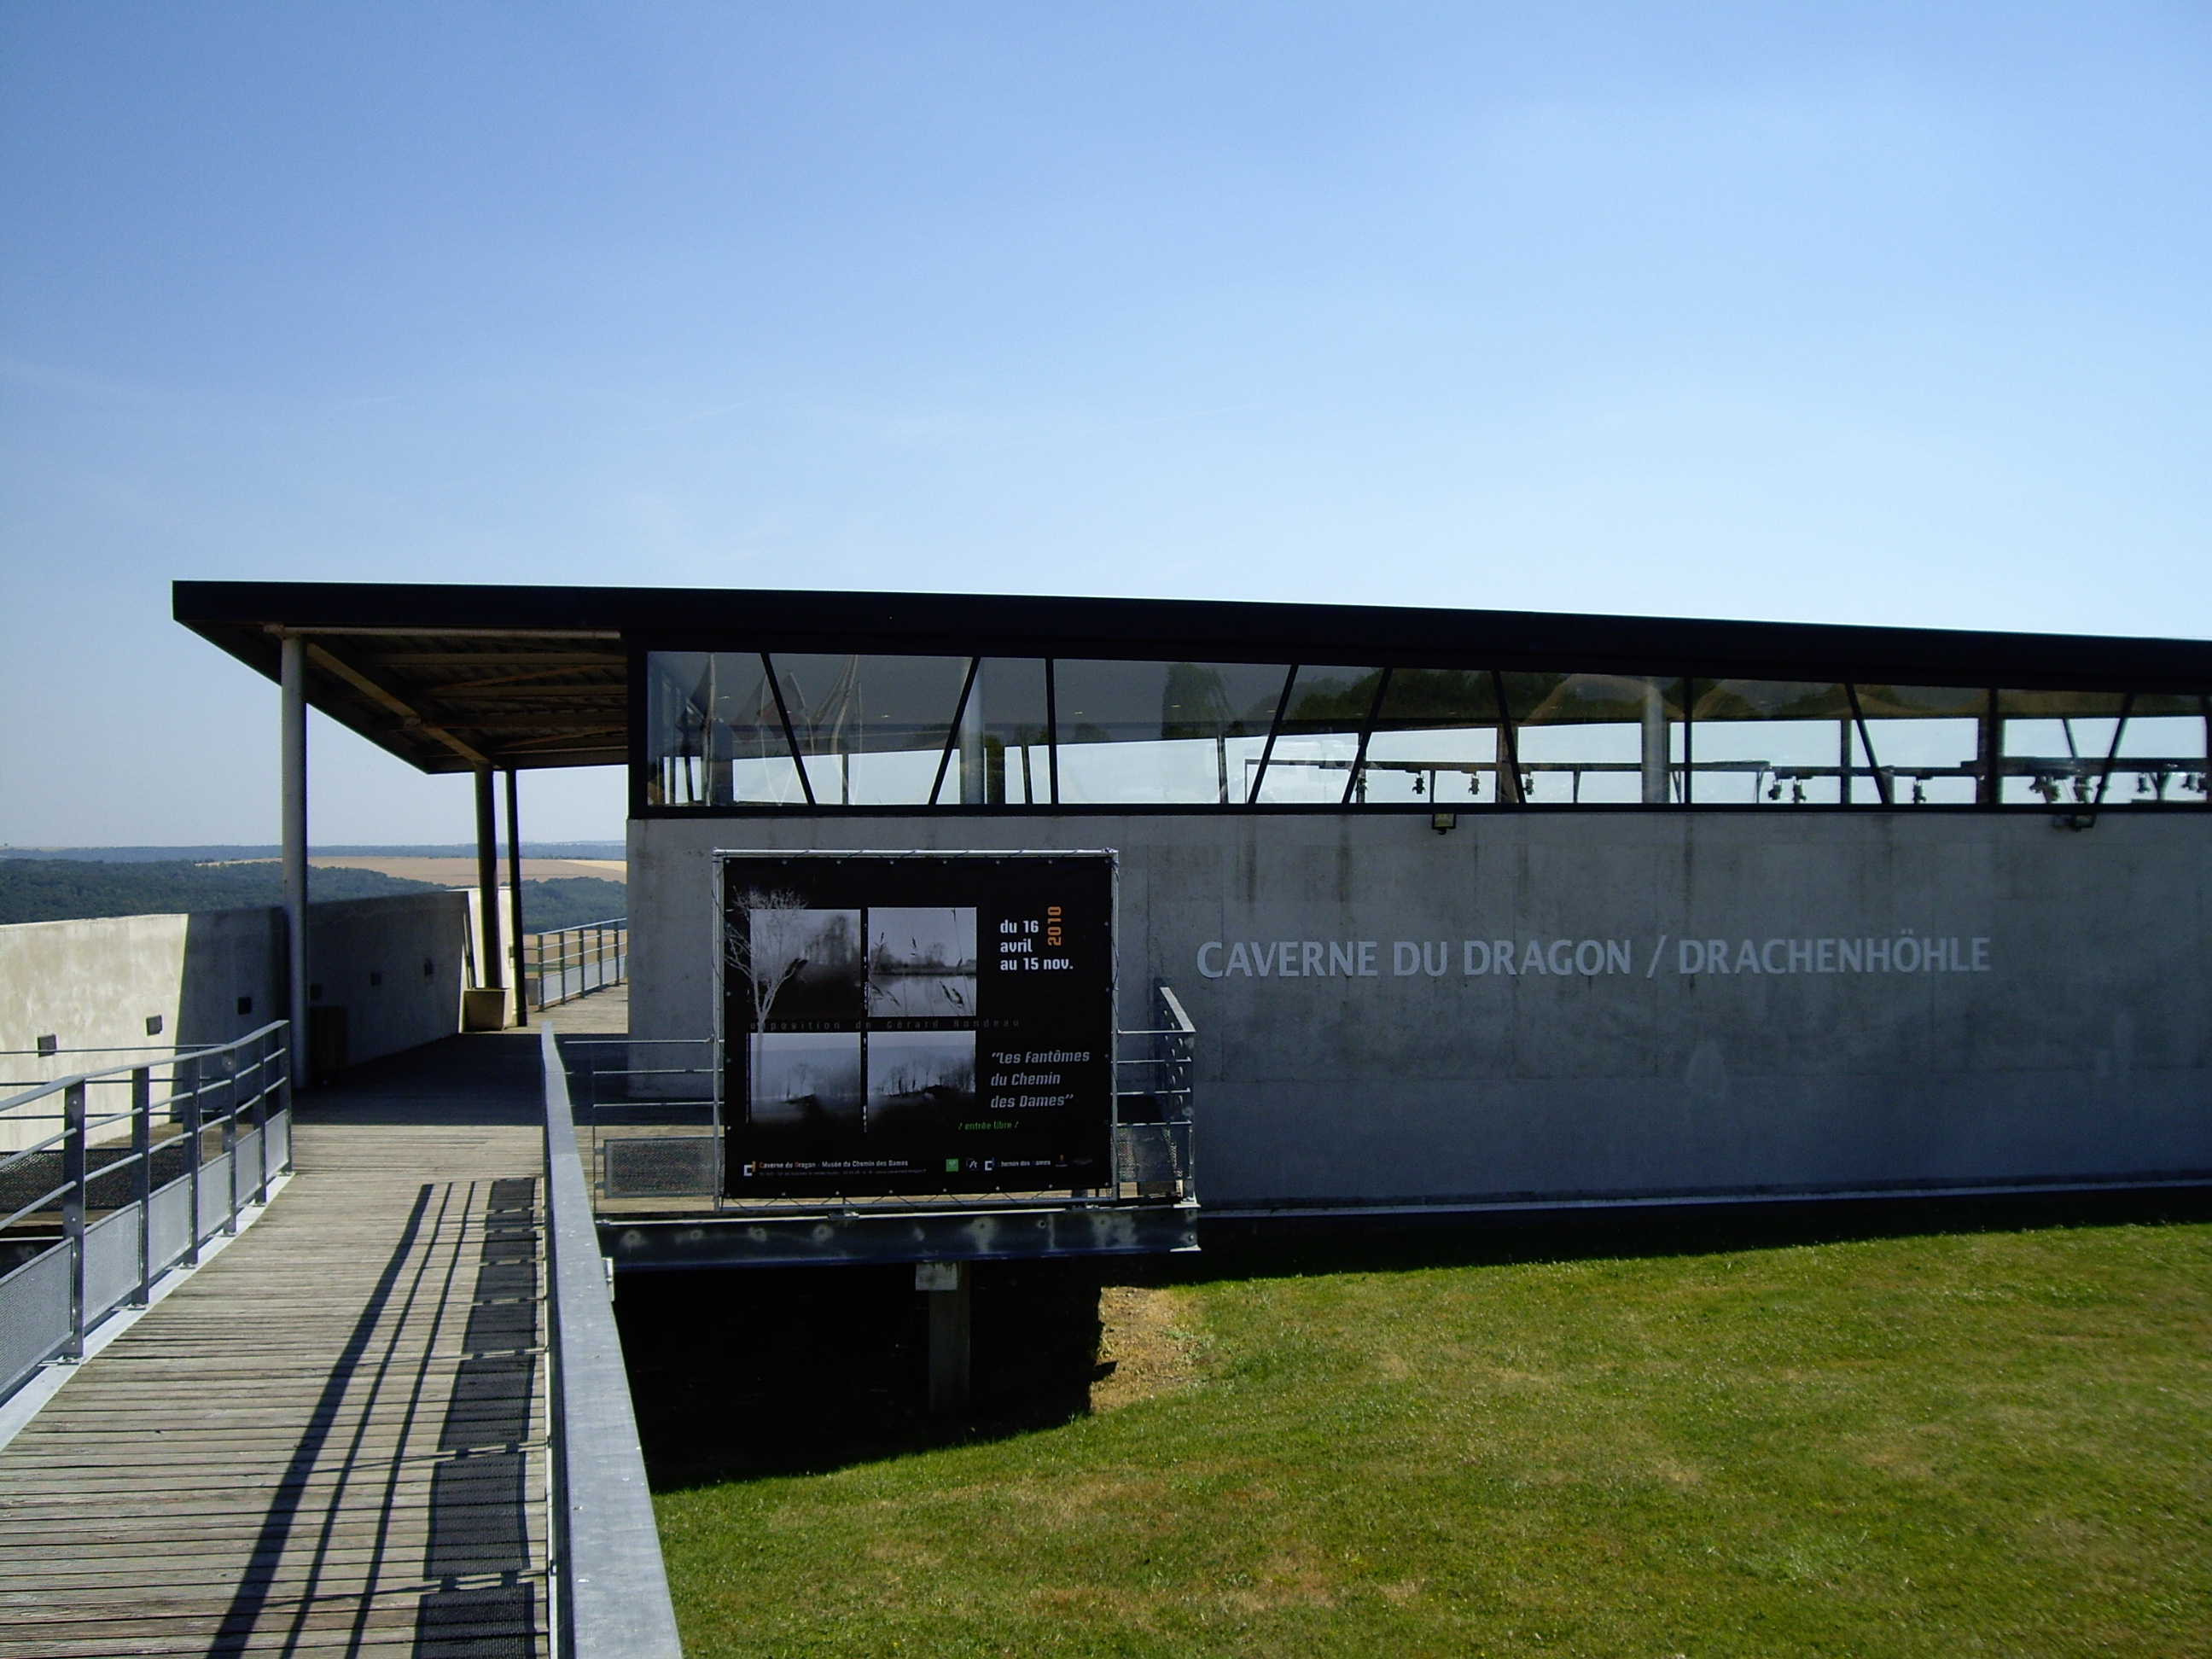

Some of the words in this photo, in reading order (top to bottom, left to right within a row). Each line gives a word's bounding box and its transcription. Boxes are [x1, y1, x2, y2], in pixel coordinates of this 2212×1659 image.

[999, 919, 1017, 934] du
[1022, 920, 1039, 934] 16
[1047, 905, 1062, 946] 2010
[999, 938, 1033, 953] avril
[1196, 940, 1378, 979] CAVERNE
[1393, 940, 1449, 977] DU
[1464, 939, 1632, 976] DRAGON
[1646, 934, 1668, 979] /
[1678, 928, 1992, 975] DRACHENHÖHLE
[999, 959, 1017, 971] au
[1022, 957, 1039, 970] 15
[1043, 958, 1074, 970] nov.
[750, 1021, 841, 1032] eposition
[855, 1020, 872, 1030] de
[886, 1019, 940, 1030] Gérard
[953, 1018, 1020, 1029] Rondeau
[990, 1073, 1008, 1086] du
[1011, 1071, 1061, 1086] Chemin
[990, 1095, 1016, 1109] des
[964, 1121, 992, 1131] entrée
[993, 1121, 1012, 1130] libre
[852, 1159, 875, 1167] Chemin
[876, 1159, 887, 1167] des
